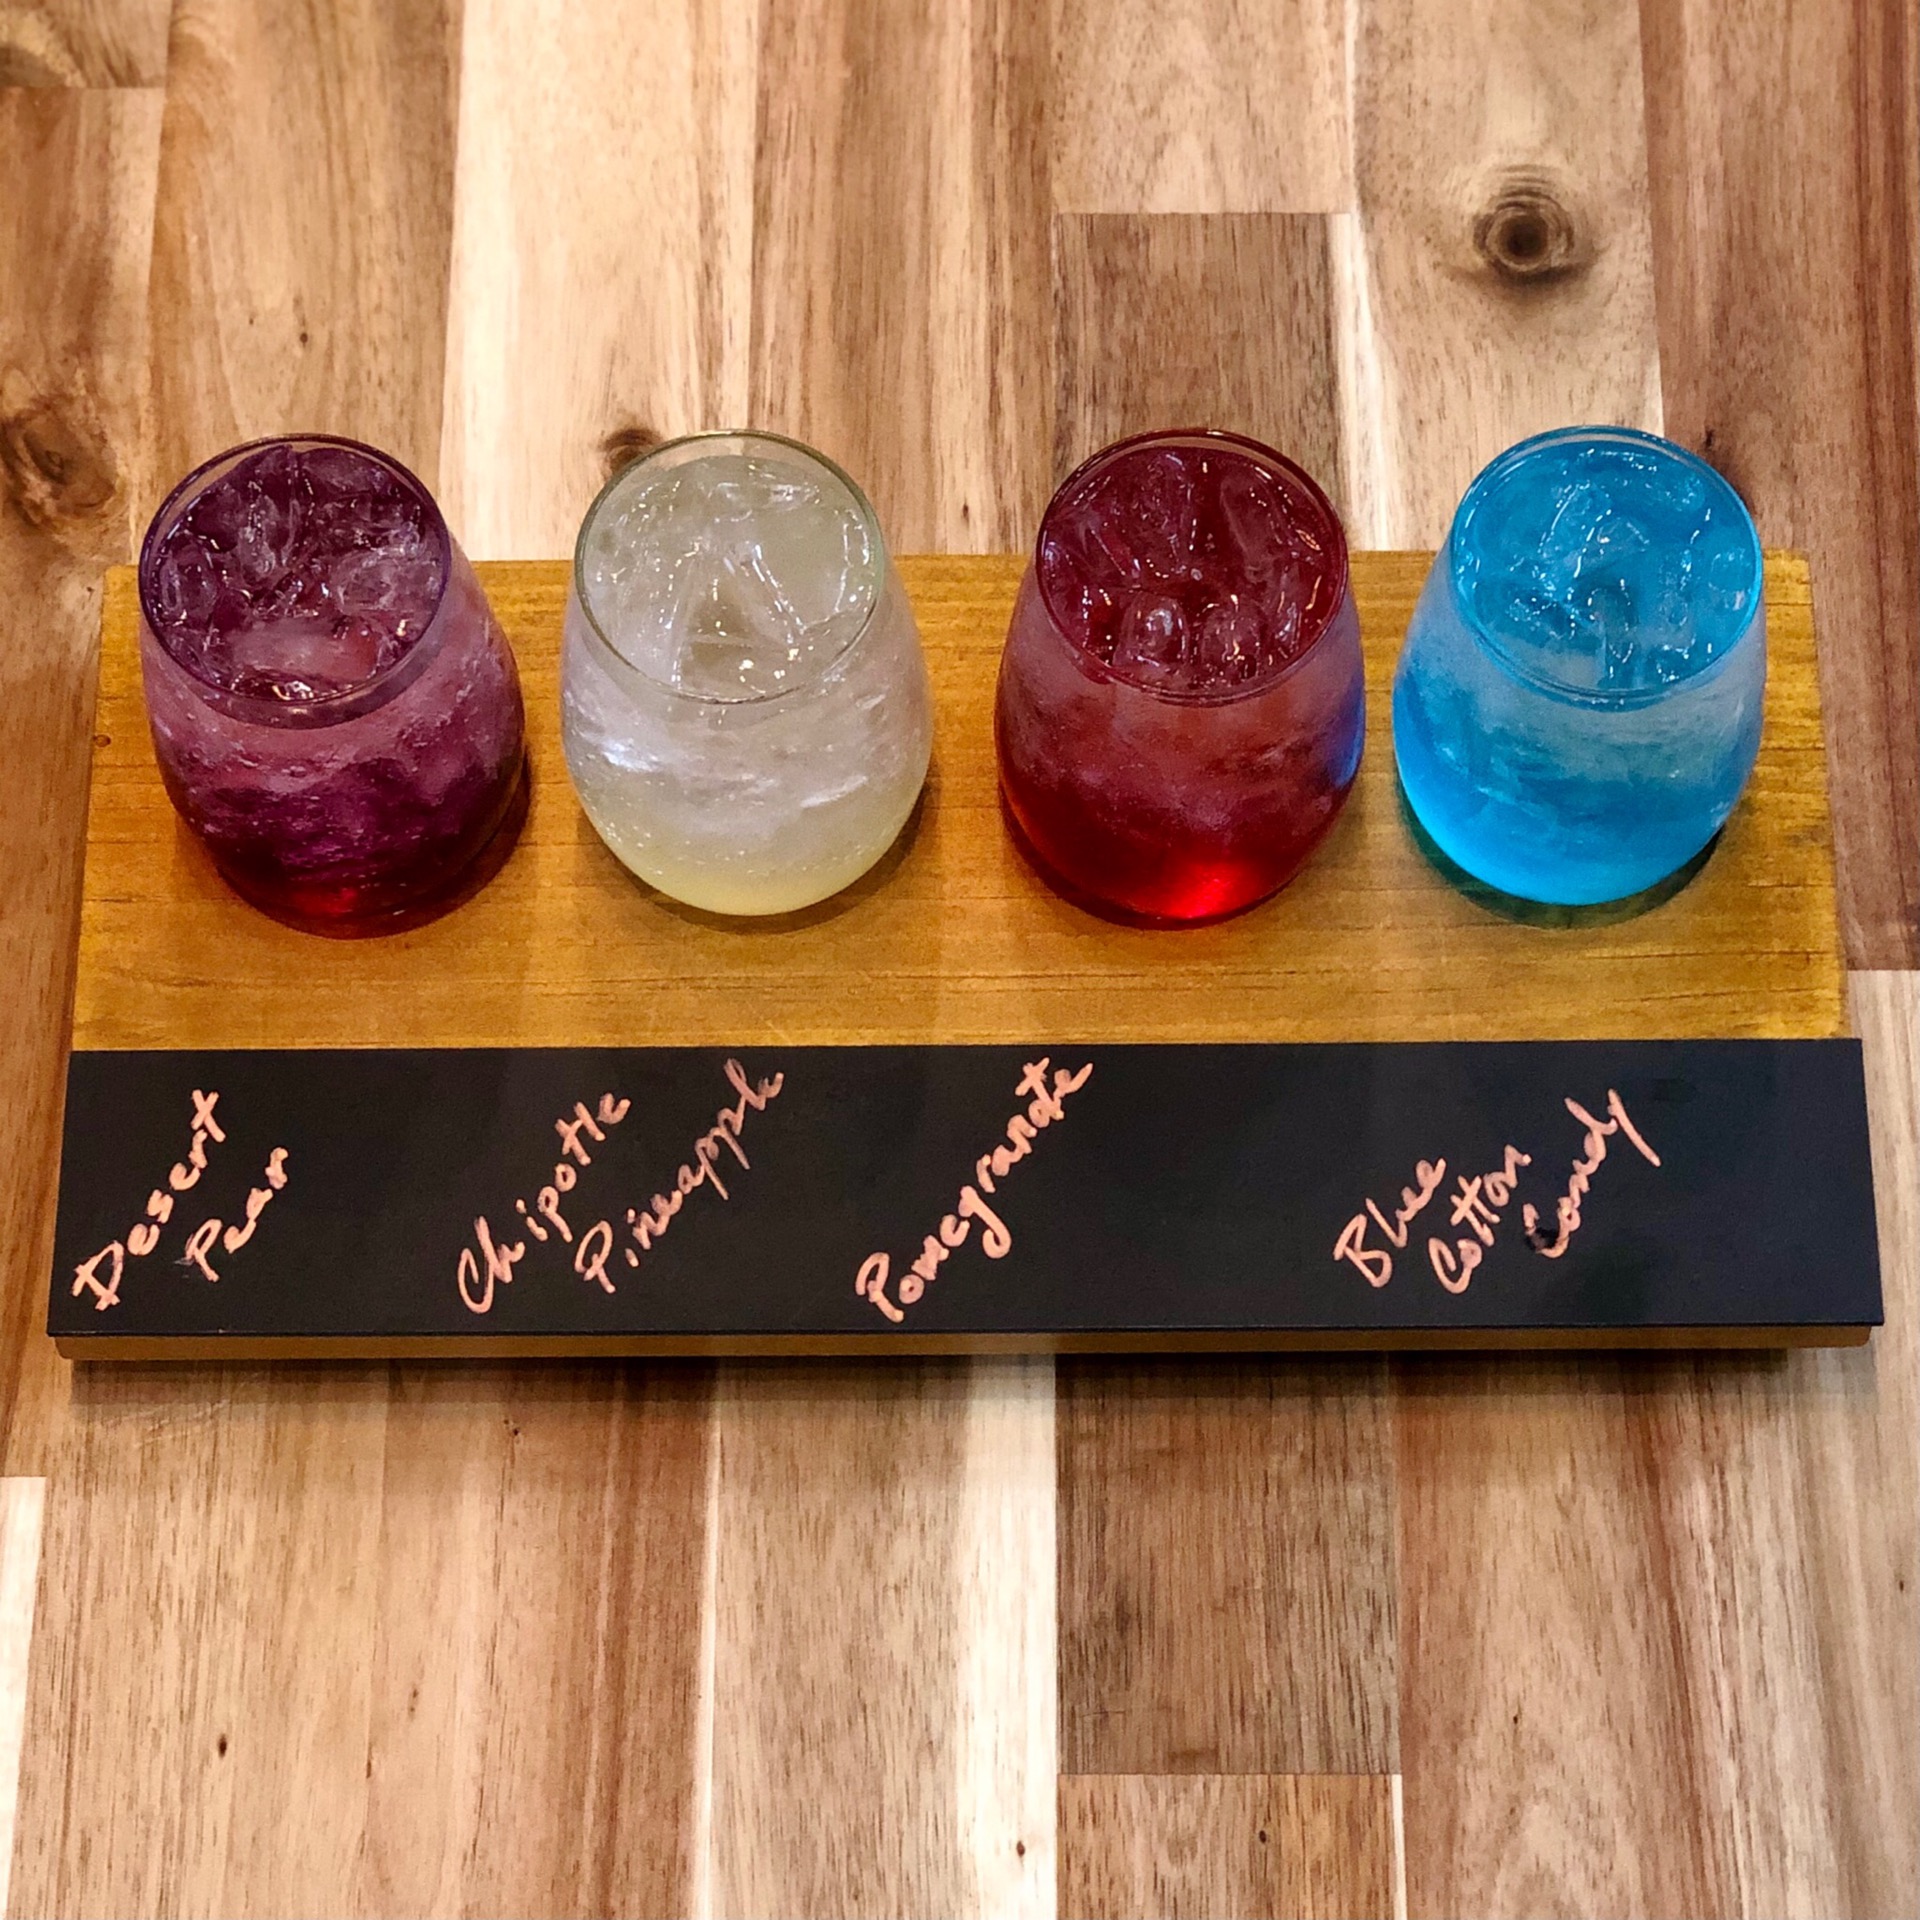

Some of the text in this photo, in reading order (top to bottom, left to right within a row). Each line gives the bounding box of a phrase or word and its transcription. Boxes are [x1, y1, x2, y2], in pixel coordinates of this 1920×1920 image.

[71, 1088, 227, 1312] Desert
[182, 1146, 290, 1284] Pear
[456, 1091, 633, 1315] Chipotle
[573, 1057, 785, 1295] Pineapple
[854, 1056, 1095, 1324] Pomegranate
[1332, 1156, 1448, 1289] Blue
[1427, 1143, 1533, 1295] Cotton
[1522, 1087, 1662, 1260] Candy
